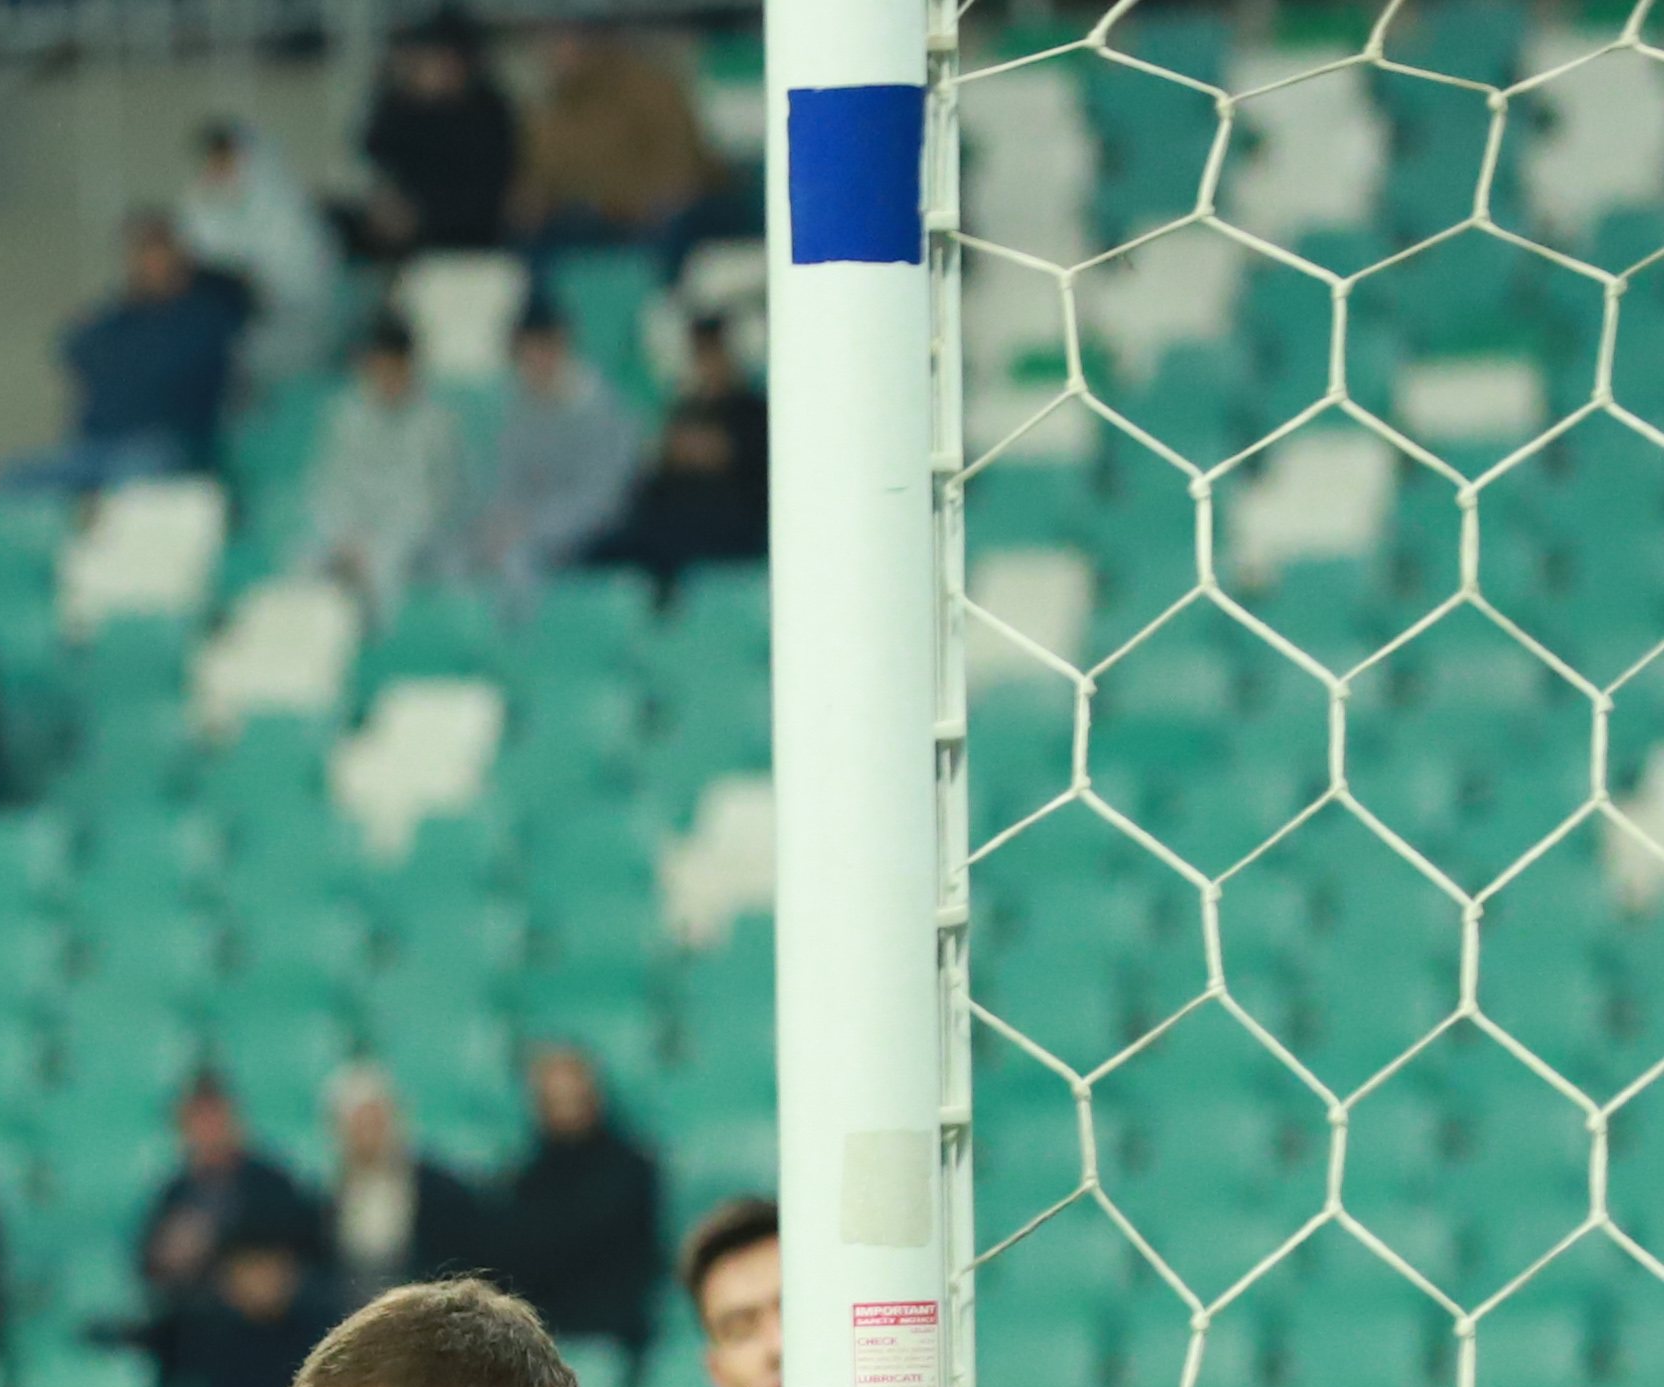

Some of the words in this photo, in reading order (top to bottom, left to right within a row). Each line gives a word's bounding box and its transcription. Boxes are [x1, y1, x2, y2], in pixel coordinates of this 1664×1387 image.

[856, 1305, 936, 1316] IMPORTANT
[857, 1337, 897, 1346] CHECK
[858, 1374, 924, 1383] LUBRICATE
